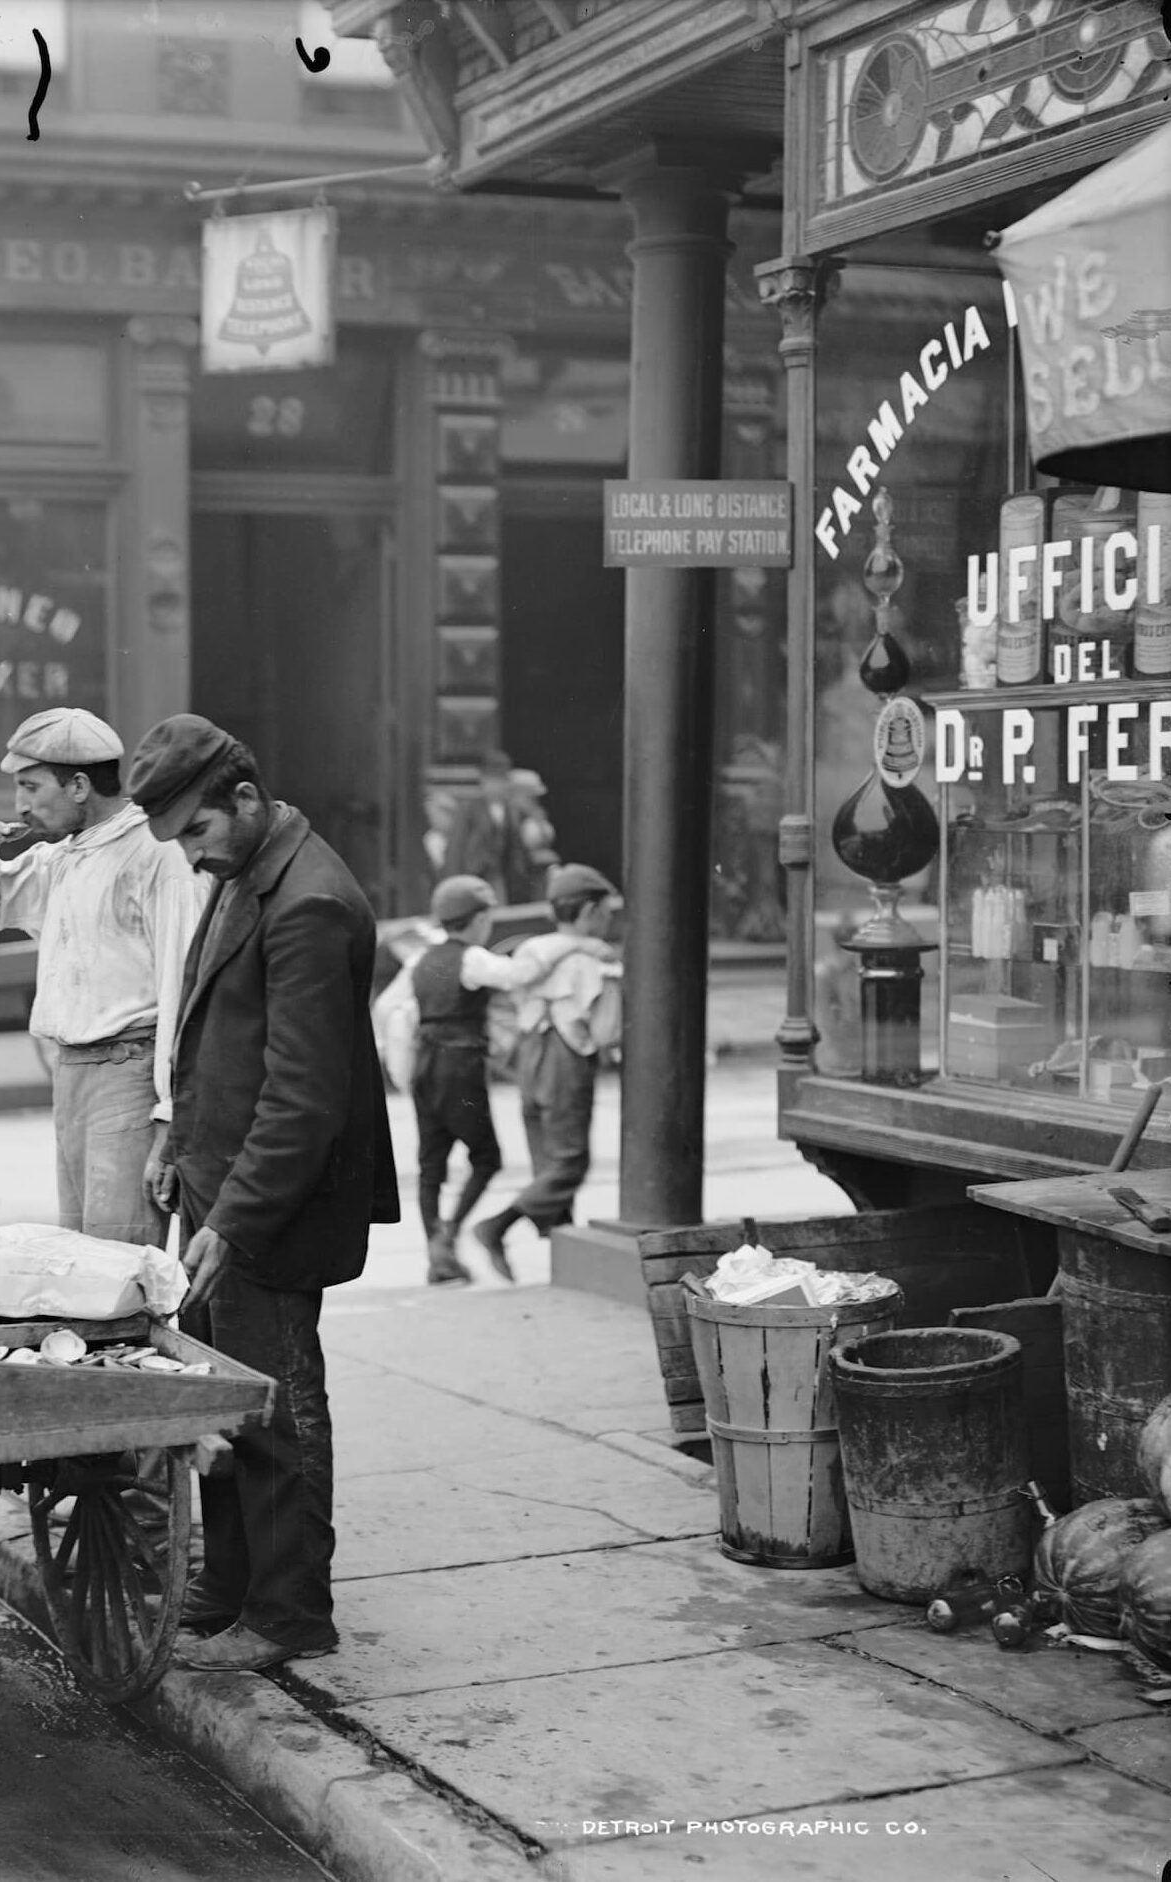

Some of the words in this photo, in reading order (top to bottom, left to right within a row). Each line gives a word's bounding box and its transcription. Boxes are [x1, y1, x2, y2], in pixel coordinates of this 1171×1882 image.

[814, 305, 992, 560] FARMACIA
[612, 492, 656, 518] LOCAL
[659, 493, 671, 517] &
[675, 493, 713, 518] LONG
[717, 493, 787, 518] DISTANCE
[610, 529, 691, 555] TELEPHONE
[696, 529, 724, 554] PAY
[1054, 639, 1121, 684] DEL
[1003, 708, 1036, 784] P.
